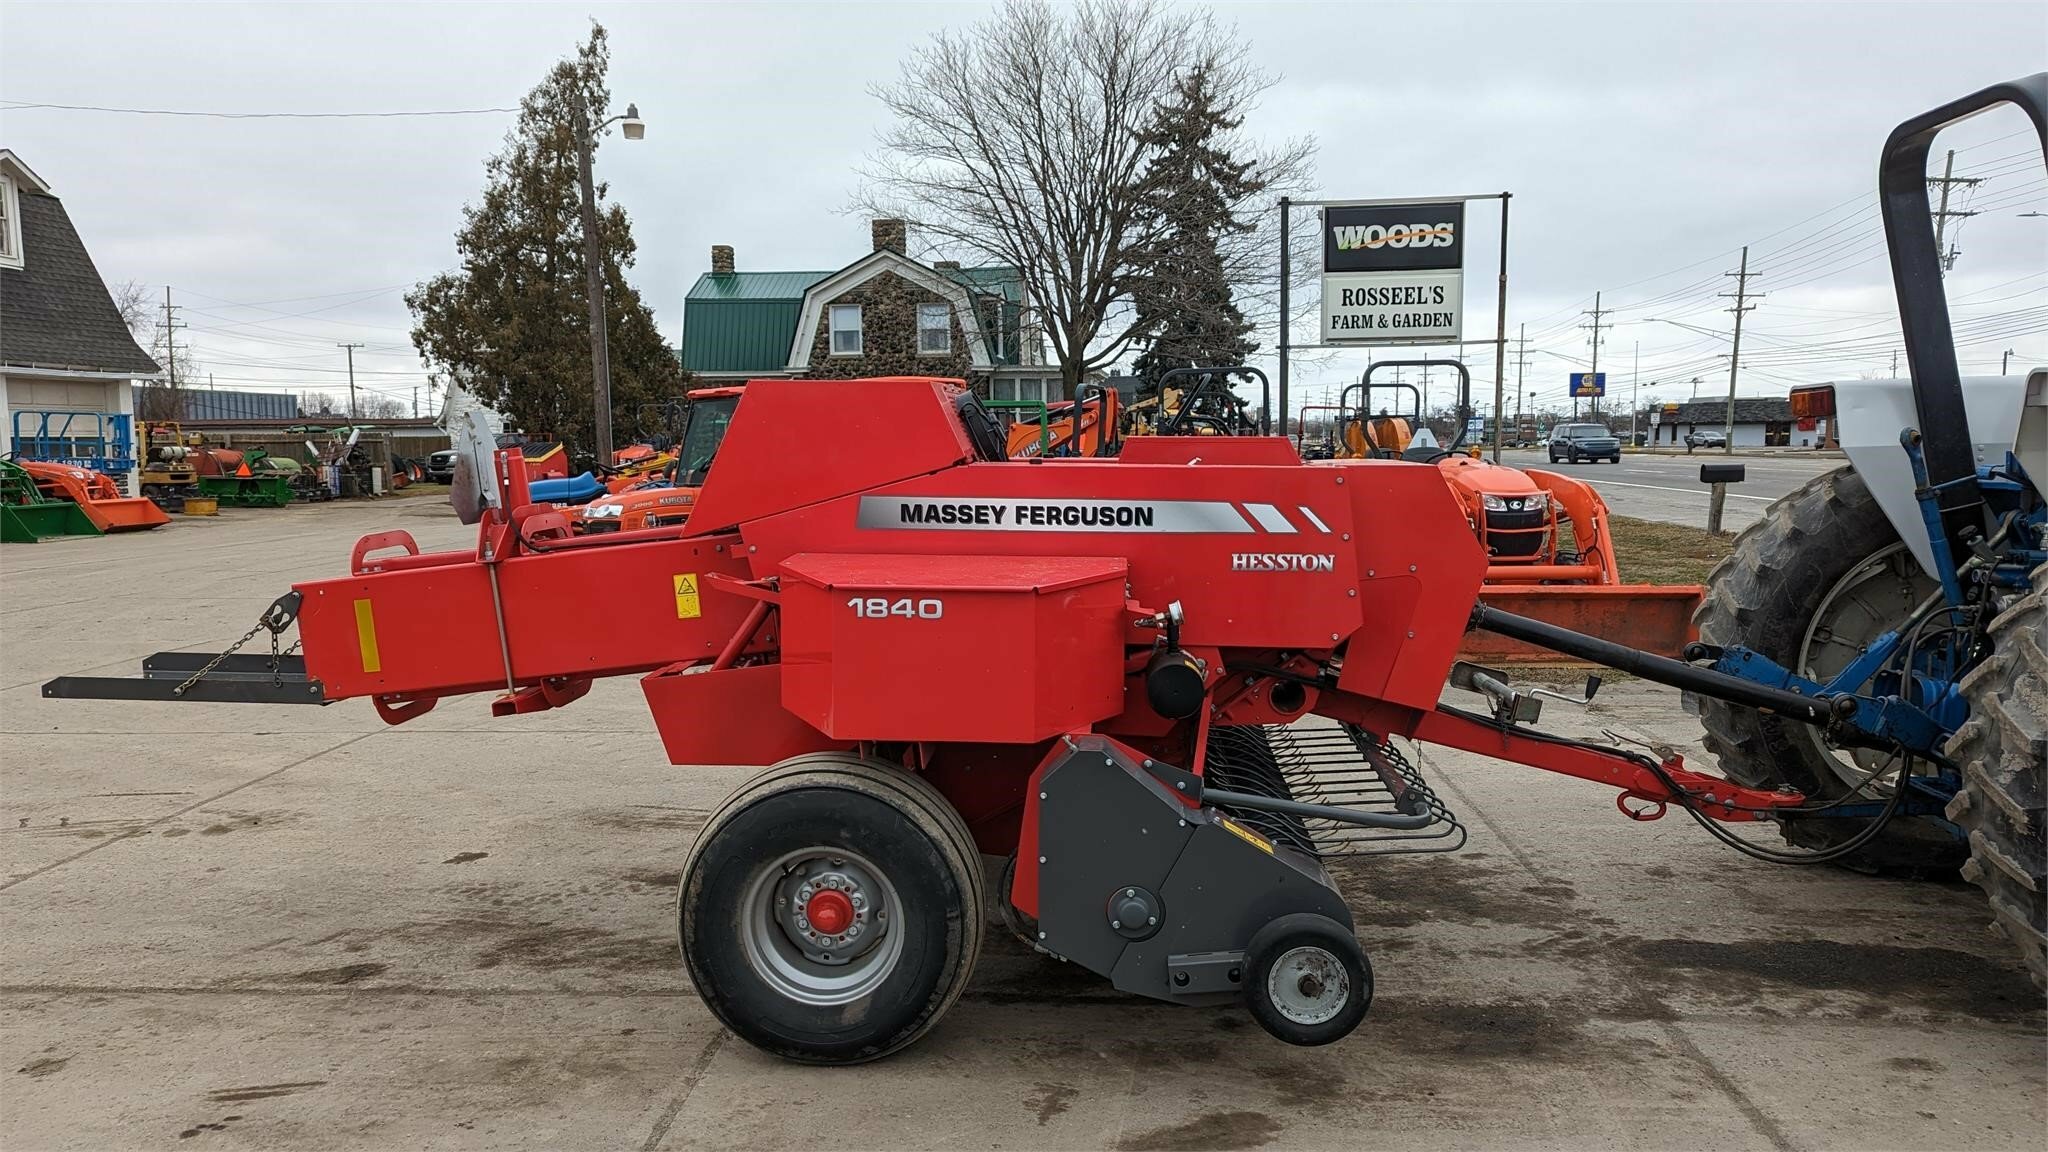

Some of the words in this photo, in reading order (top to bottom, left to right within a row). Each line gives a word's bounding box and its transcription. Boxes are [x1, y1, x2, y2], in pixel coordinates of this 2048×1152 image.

[1333, 223, 1454, 250] WOODS
[1341, 286, 1444, 306] ROSSEEL'S
[1331, 314, 1374, 330] FARM
[1377, 314, 1388, 328] &
[1392, 312, 1454, 329] GARDEN
[900, 503, 1006, 526] MASSEY
[1015, 505, 1154, 527] FERGUSON
[1231, 553, 1335, 572] HESSTON
[847, 597, 943, 619] 1840
